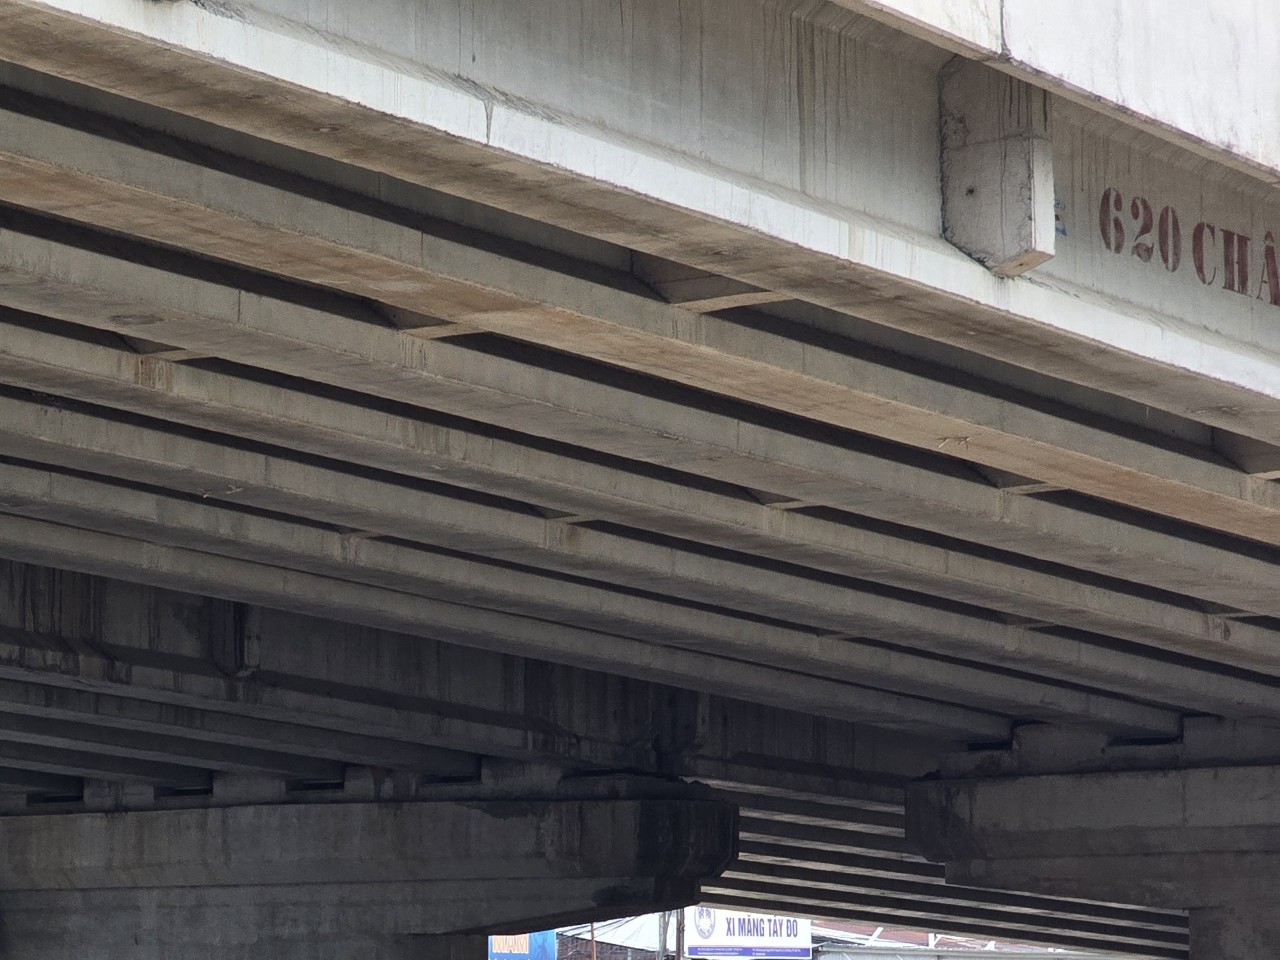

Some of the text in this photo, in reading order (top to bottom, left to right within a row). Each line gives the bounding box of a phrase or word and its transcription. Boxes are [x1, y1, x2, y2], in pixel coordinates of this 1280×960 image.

[1099, 187, 1182, 274] 620
[726, 917, 735, 937] XI
[738, 914, 765, 937] MĂNG
